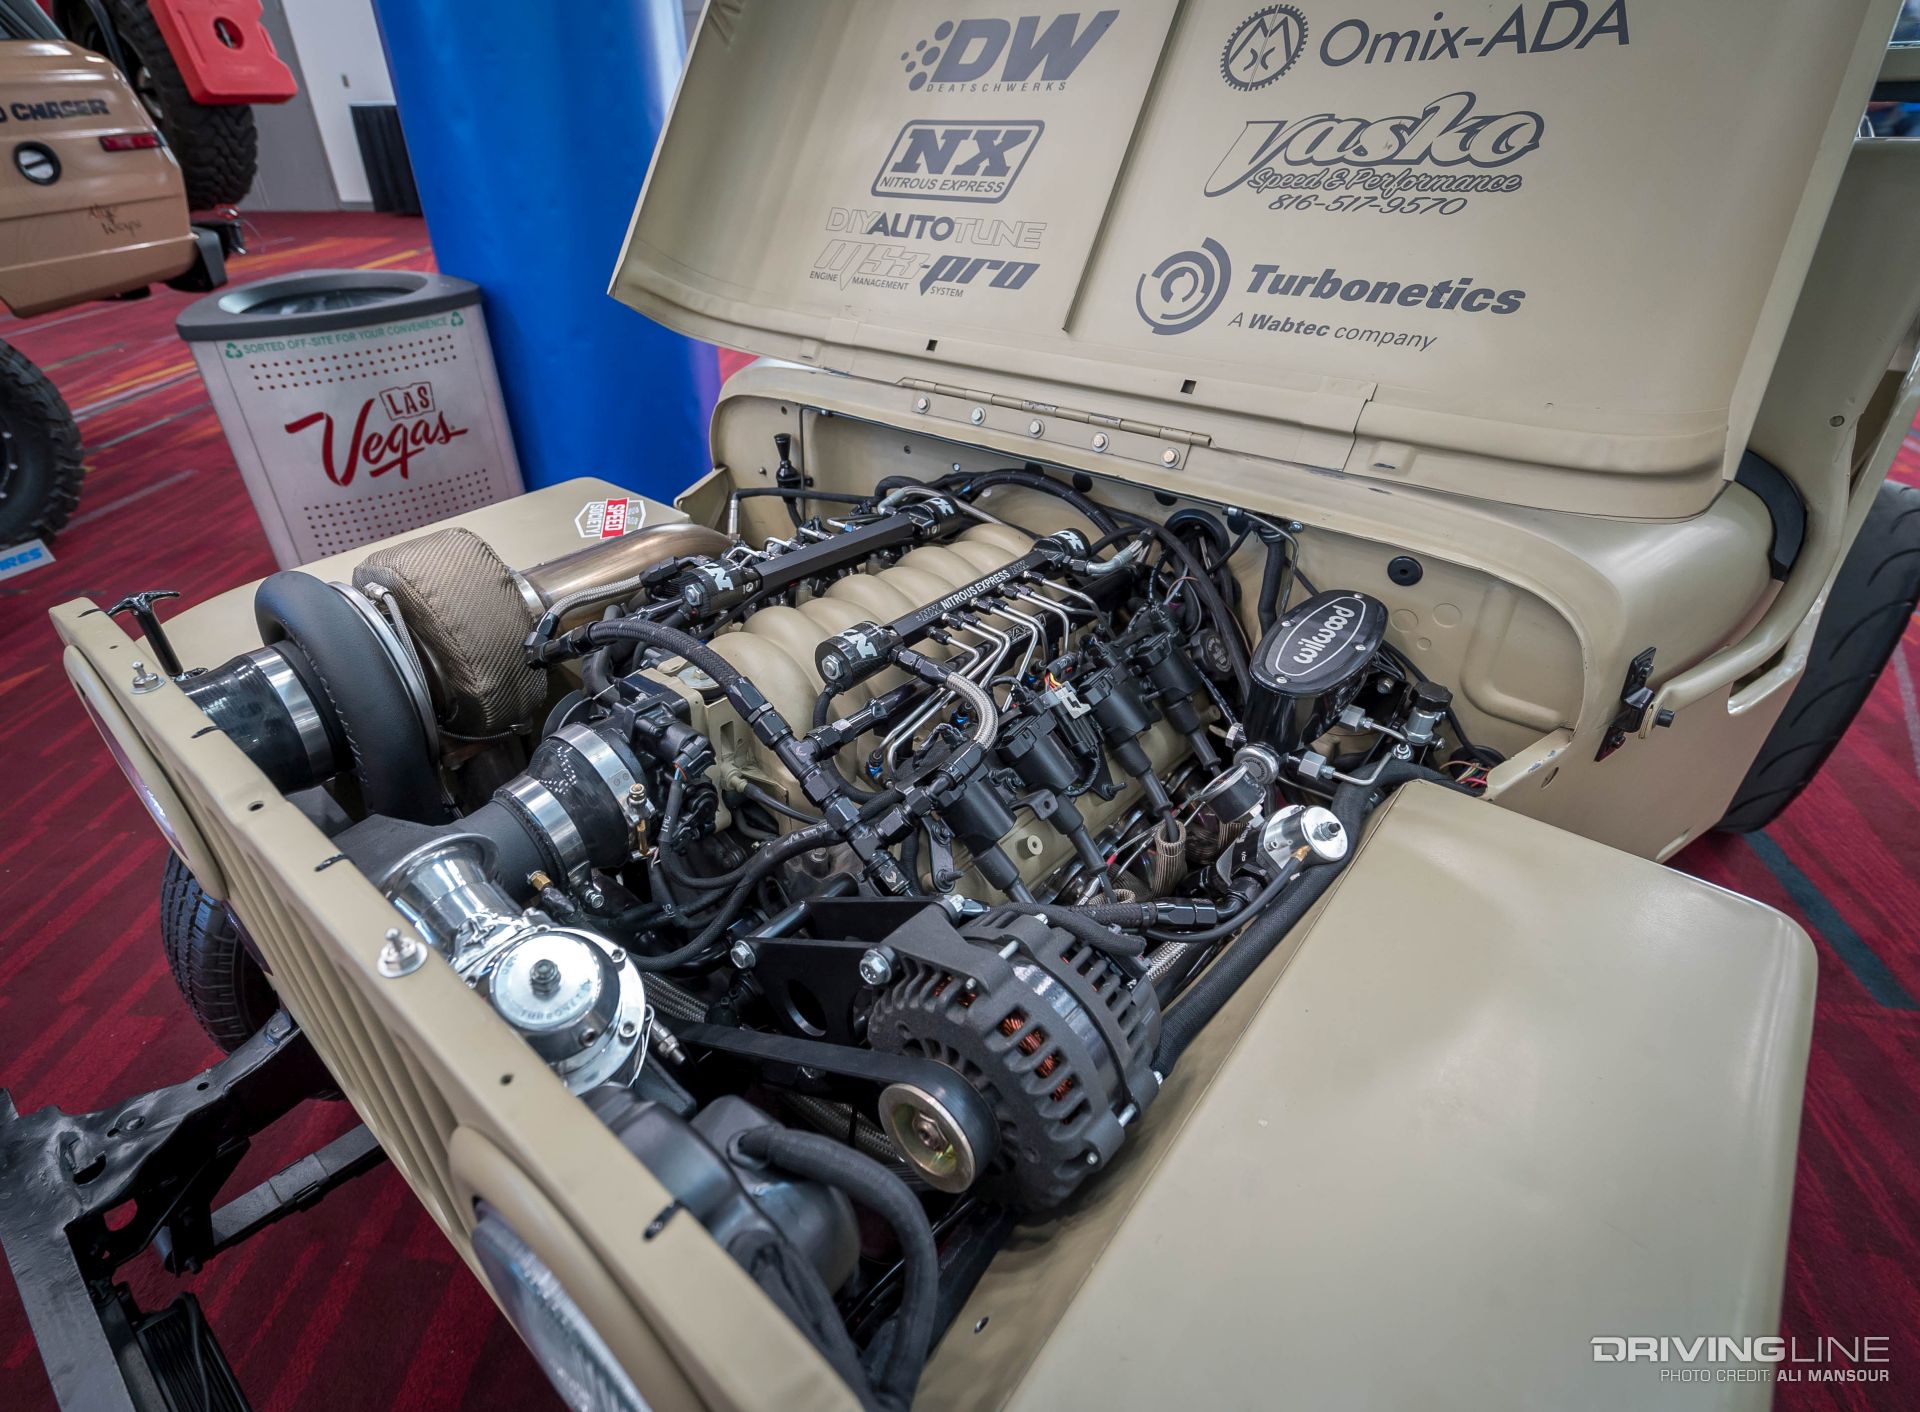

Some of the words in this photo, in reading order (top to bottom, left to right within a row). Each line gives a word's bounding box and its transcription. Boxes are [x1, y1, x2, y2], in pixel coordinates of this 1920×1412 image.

[930, 9, 1121, 83] DW
[1319, 0, 1631, 67] Omix-ADA
[926, 81, 1067, 93] DEATSCHWERKS
[11, 99, 110, 121] CHASER
[890, 128, 1033, 178] NX
[880, 176, 938, 191] NITROUS
[939, 178, 1006, 194] EXPRESS
[1246, 167, 1329, 194] Speed
[1323, 168, 1351, 192] &
[1346, 167, 1523, 200] Performance
[1268, 193, 1468, 216] 816-517-9570
[825, 206, 1048, 250] DIYAUTOTUNE
[809, 270, 839, 283] ENGINE
[852, 276, 910, 291] MANAGEMENT
[930, 285, 964, 298] SYSTEM
[1245, 263, 1527, 316] Turbonetics
[242, 341, 286, 355] SORTED
[287, 335, 334, 350] OFF-SITE
[336, 332, 357, 344] FOR
[358, 327, 385, 342] YOUR
[387, 316, 448, 336] CONVENIENCE
[1228, 312, 1244, 329] A
[1248, 313, 1331, 338] Wabtec
[1333, 326, 1438, 352] company
[386, 385, 431, 417] LAS
[284, 399, 469, 487] Vegas
[585, 504, 605, 533] SOCIETY
[604, 503, 626, 531] SPEED
[940, 586, 979, 611] NITROUS
[977, 569, 1011, 593] EXPRESS
[1292, 604, 1356, 665] wilwood
